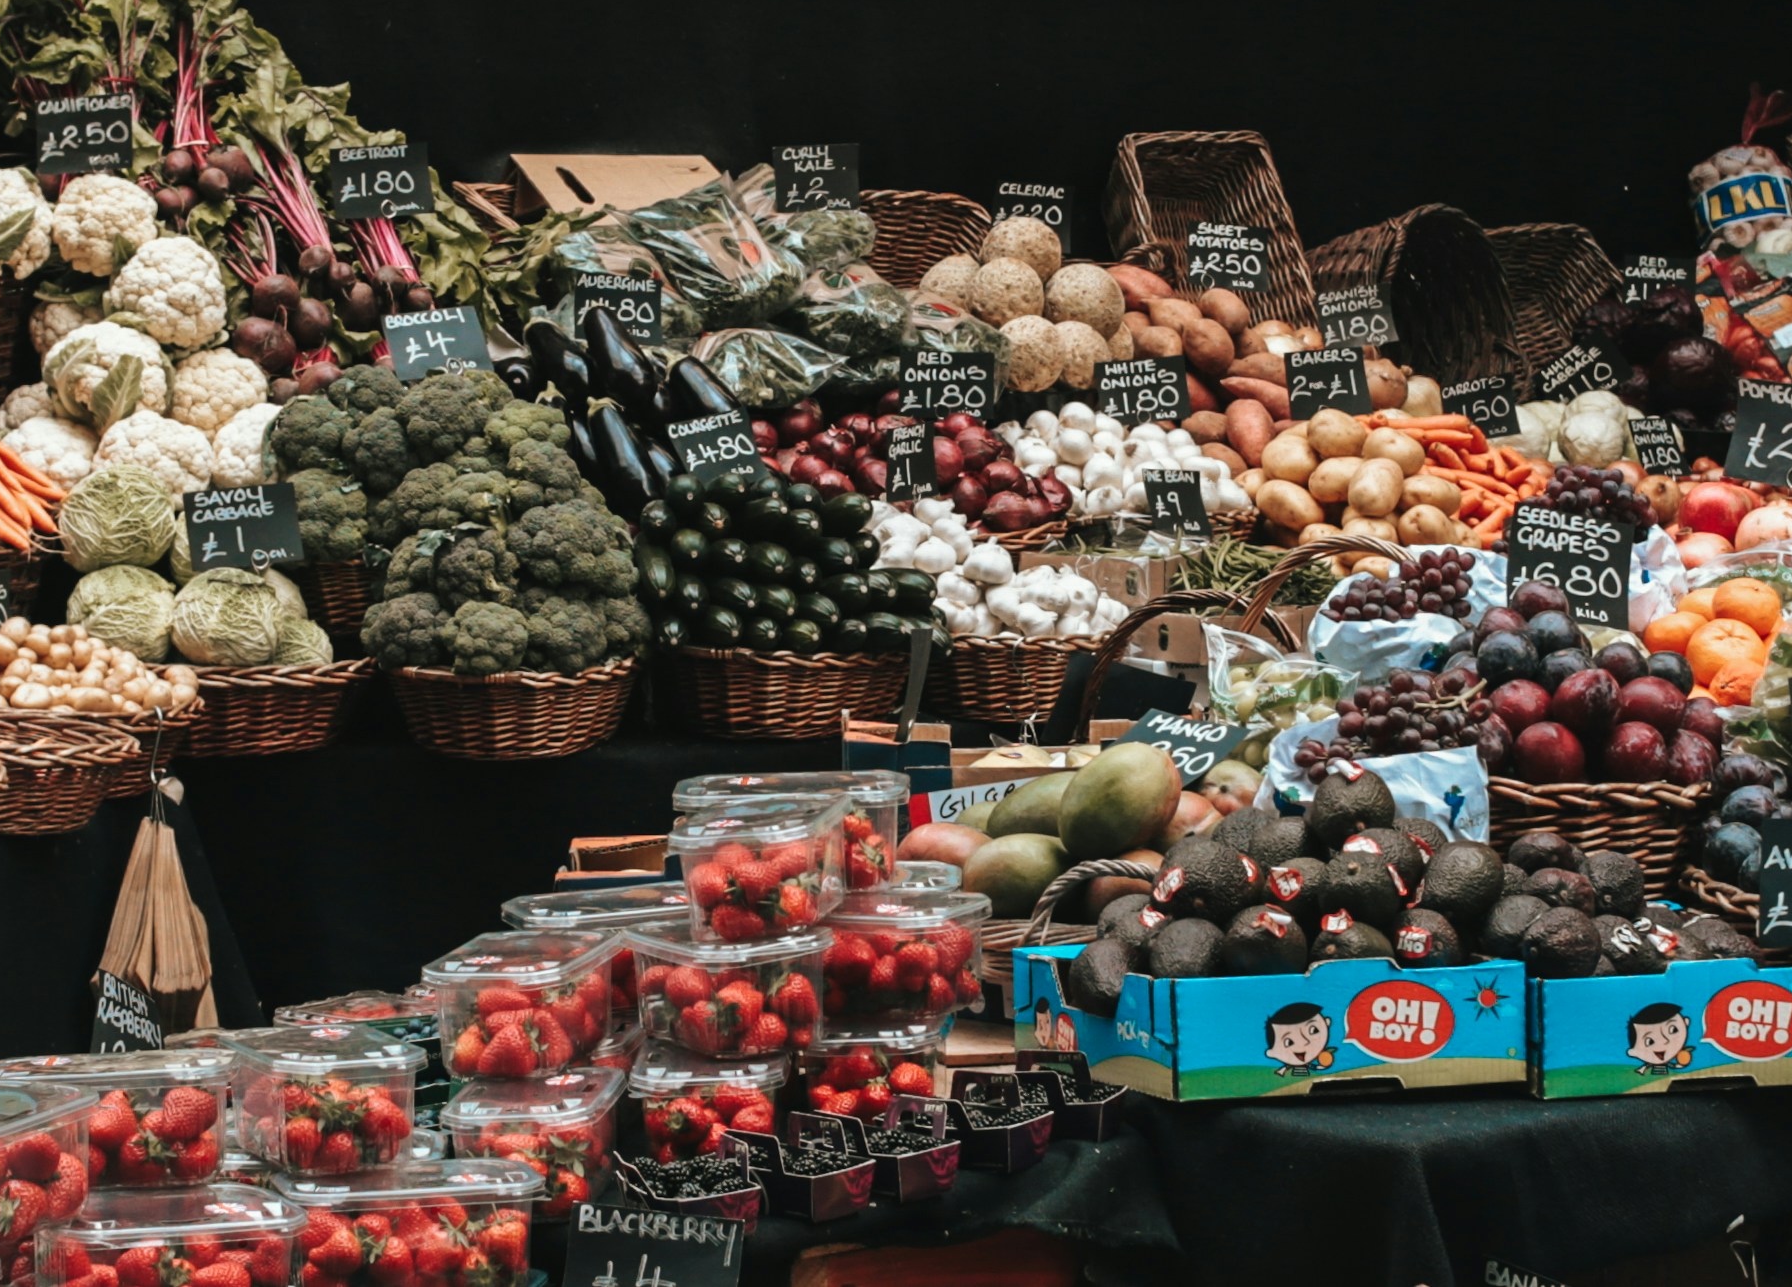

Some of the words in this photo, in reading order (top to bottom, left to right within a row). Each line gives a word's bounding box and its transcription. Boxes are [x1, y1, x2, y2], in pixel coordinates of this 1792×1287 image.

[40, 120, 129, 164] £2.50
[339, 143, 408, 162] BEETROOT
[781, 145, 830, 163] CURLY
[340, 169, 415, 204] £1.80
[785, 177, 830, 208] £2
[999, 182, 1065, 199] CELERIAC
[1708, 178, 1785, 222] LKL
[1197, 222, 1249, 239] SWEET
[1188, 235, 1265, 252] POTATOES
[1189, 253, 1263, 277] £2.50
[1625, 267, 1688, 281] CABBAGE
[1639, 257, 1668, 269] RED
[577, 273, 657, 294] AUBERGINE
[1317, 285, 1379, 307] SPANISH
[385, 308, 466, 330] BROCCOLI
[1320, 298, 1384, 317] ONIONS
[1323, 314, 1389, 346] £1.80
[408, 330, 456, 364] £4
[916, 351, 953, 366] RED
[1291, 348, 1357, 368] BAKERS
[904, 365, 987, 382] ONIONS
[1103, 359, 1156, 376] WHITE
[1540, 345, 1584, 381] WHITE
[1542, 345, 1602, 393] CABBAGE
[1100, 370, 1178, 390] ONIONS
[1290, 375, 1312, 402] 2
[1328, 369, 1358, 400] £1
[1441, 375, 1506, 400] CARROTS
[900, 385, 986, 413] £1.80
[1104, 384, 1180, 418] £1.80
[668, 410, 744, 439] COURGETTE
[892, 425, 926, 442] FRENCH
[1630, 419, 1668, 433] ENGLISH
[686, 432, 756, 473] £4.80
[889, 440, 923, 461] GARLIC
[1634, 434, 1674, 446] ONIONS
[892, 457, 912, 492] £1
[1165, 471, 1196, 485] BEAN
[193, 484, 262, 512] SAVOY
[1156, 490, 1183, 519] £9
[192, 501, 275, 526] CABBAGE
[1516, 505, 1621, 544] SEEDLESS
[1516, 525, 1610, 562] GRAPES
[1146, 714, 1228, 744] MANGO
[102, 971, 149, 1017] BRITISH
[96, 995, 162, 1051] RASPBERRY
[1117, 1020, 1138, 1043] PICK
[577, 1202, 739, 1268] BLACKBERRY
